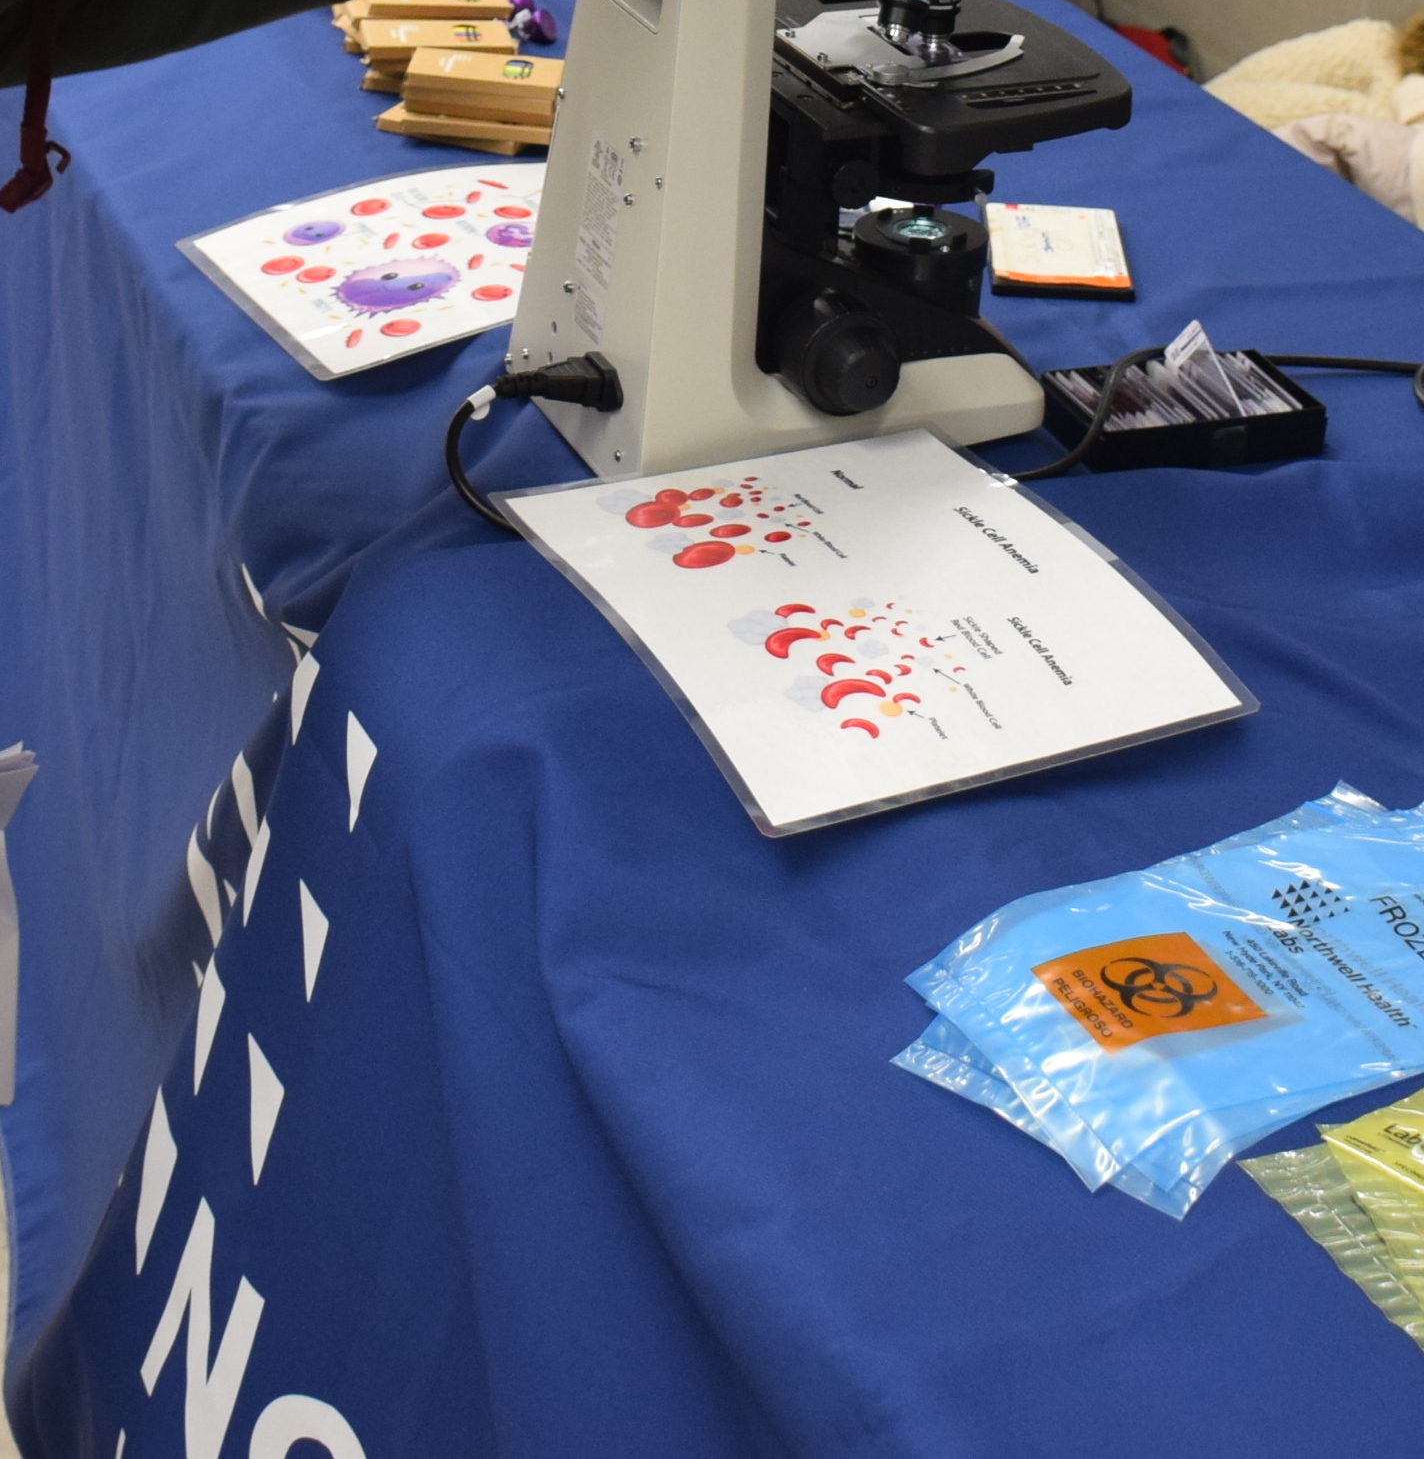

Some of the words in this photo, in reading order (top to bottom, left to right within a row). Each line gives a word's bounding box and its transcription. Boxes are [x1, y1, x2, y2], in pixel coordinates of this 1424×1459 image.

[953, 506, 985, 528] Sickle
[982, 527, 1007, 543] Cell
[999, 542, 1039, 574] Anemia
[977, 646, 992, 660] Cell
[978, 631, 1004, 656] Shaped
[1006, 616, 1032, 639] Sickle
[1028, 638, 1049, 655] Cell
[1041, 654, 1073, 686] Anemia
[1223, 930, 1239, 946] New
[1238, 947, 1257, 964] Hyde
[1272, 980, 1287, 990] NY
[1267, 926, 1305, 954] abs
[1072, 969, 1133, 1029] BIOHAZARD
[1259, 951, 1289, 978] Lakeville
[1288, 978, 1309, 996] Road
[1287, 917, 1368, 985] Northwell
[1358, 979, 1413, 1028] Health
[1052, 977, 1113, 1038] PELIGROSO
